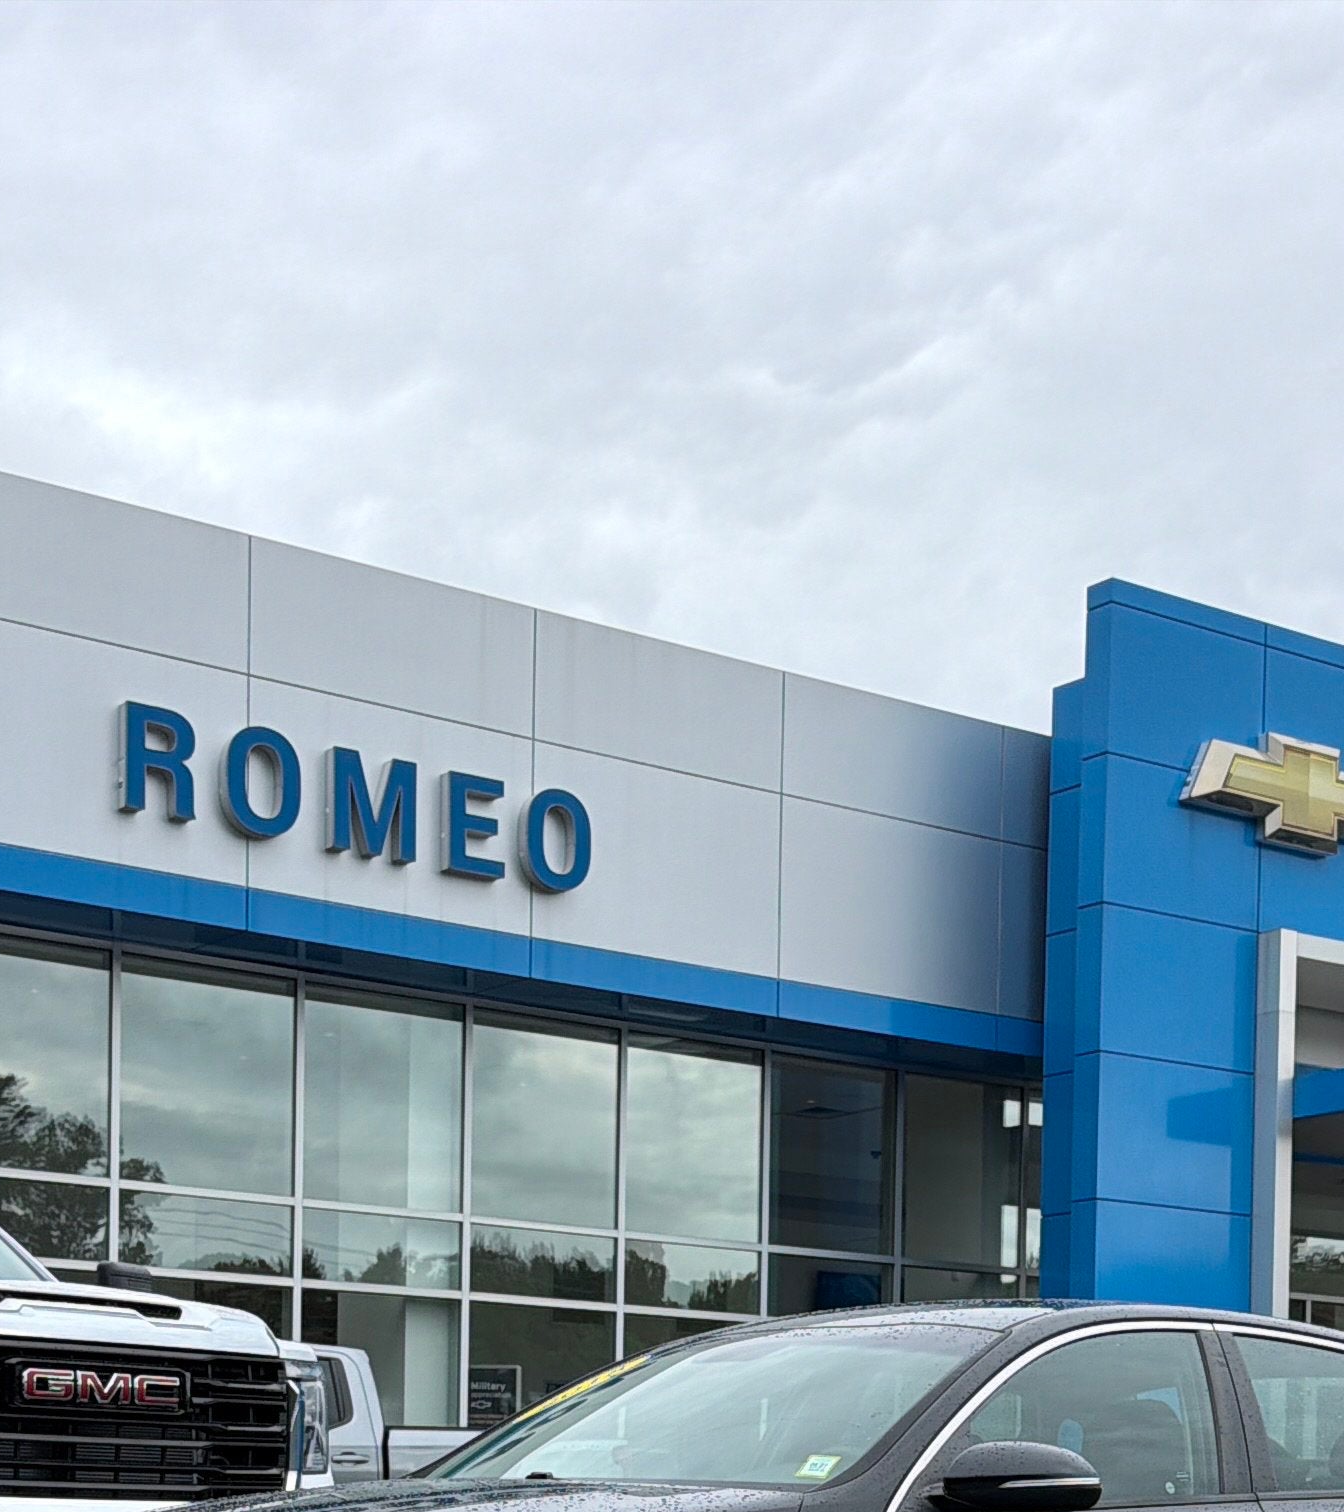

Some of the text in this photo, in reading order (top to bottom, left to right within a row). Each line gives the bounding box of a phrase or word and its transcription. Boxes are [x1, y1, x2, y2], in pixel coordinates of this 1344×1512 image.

[118, 700, 592, 893] ROMEO
[22, 1367, 180, 1410] GMC
[470, 1381, 507, 1392] Military
